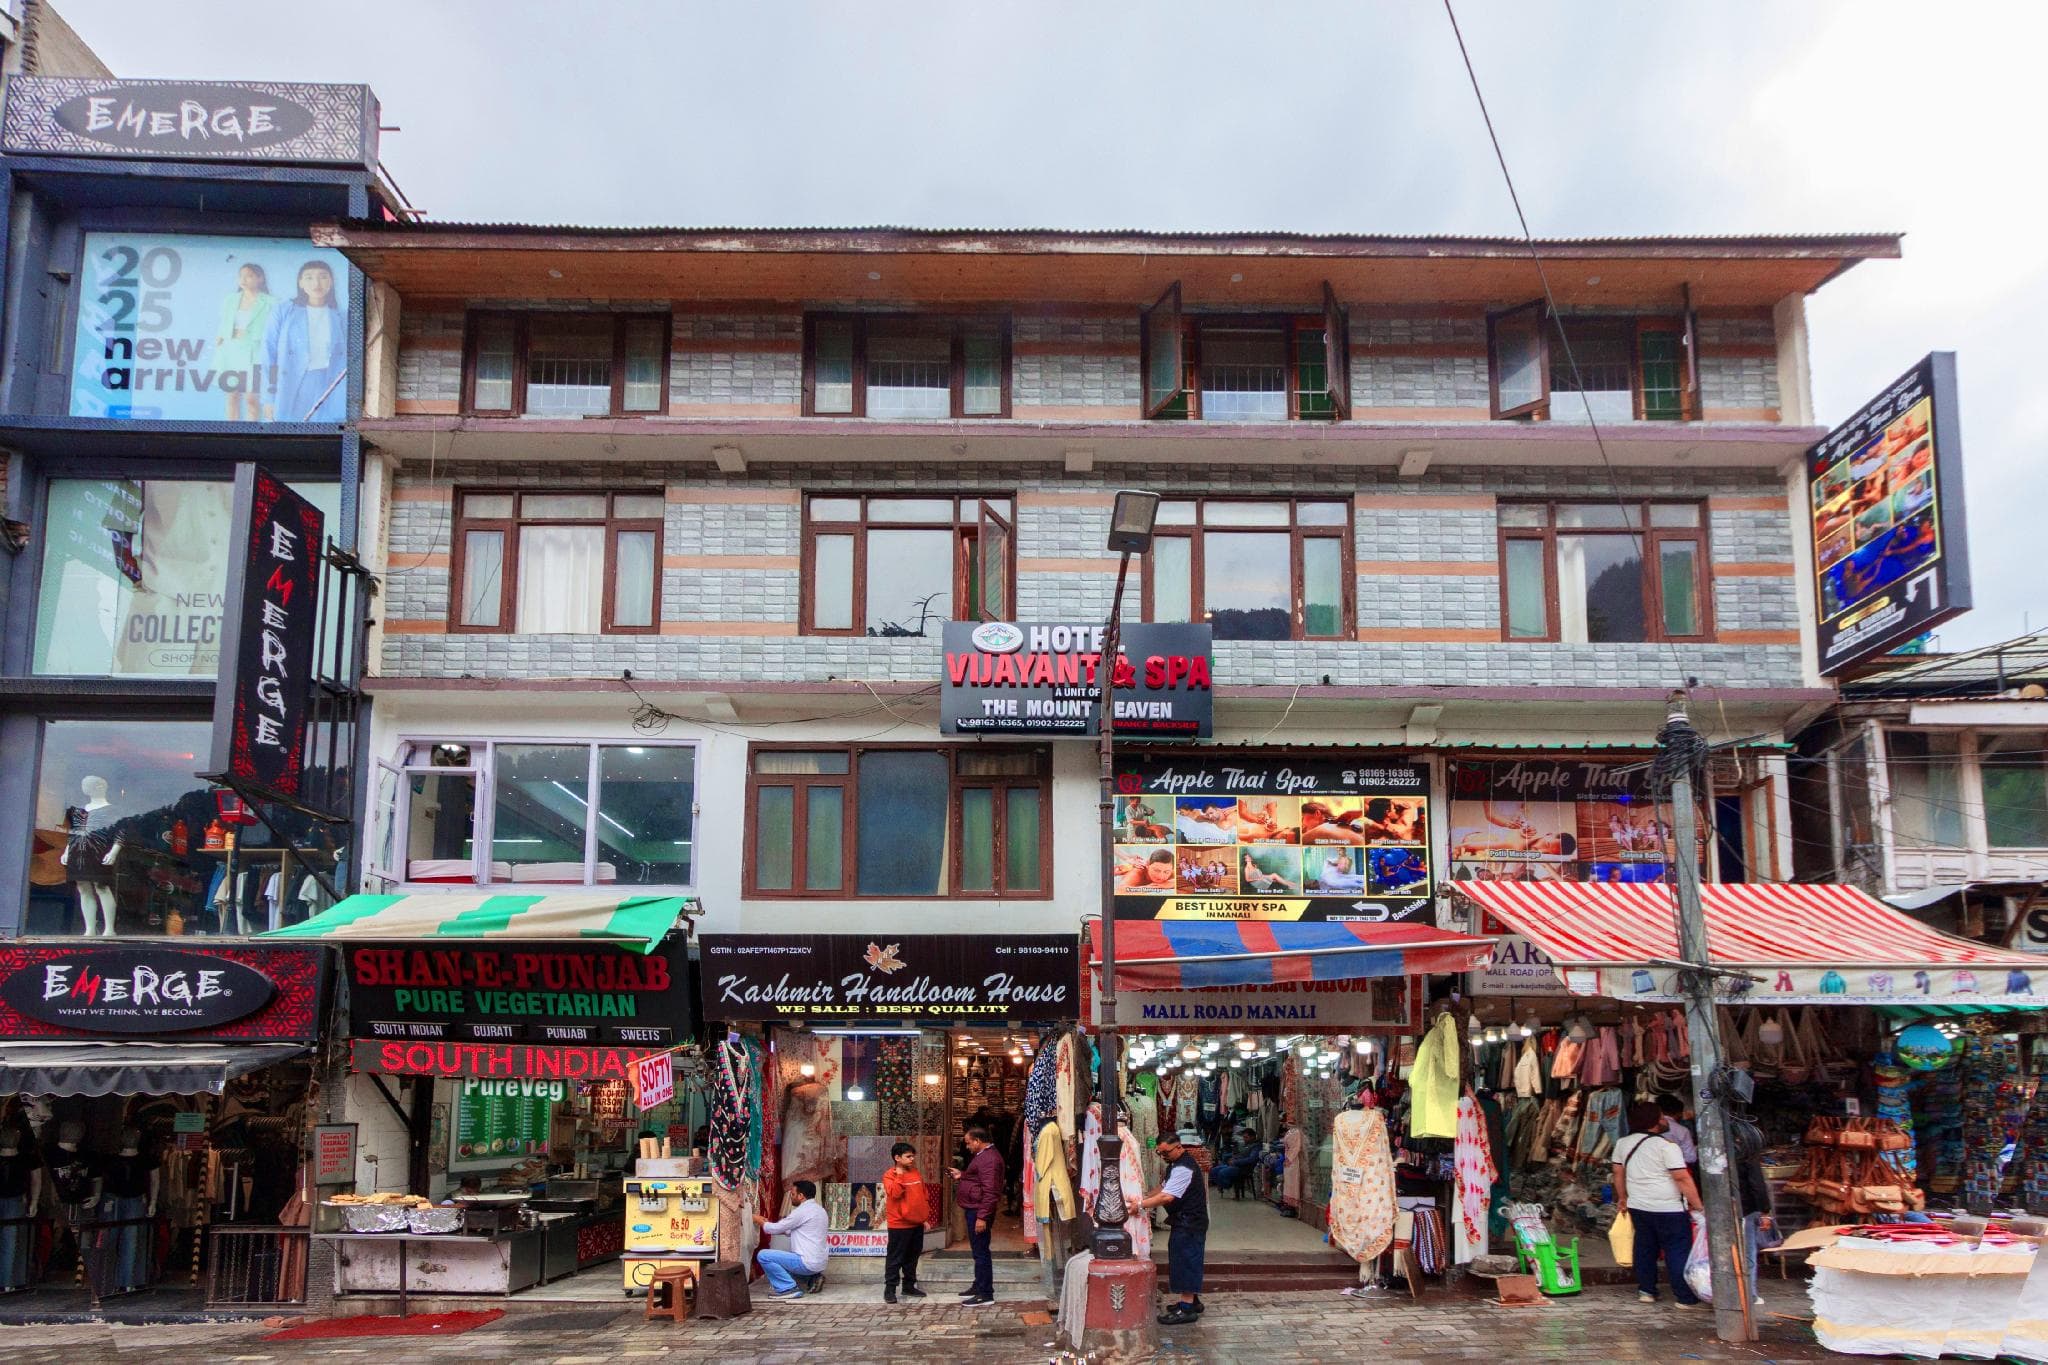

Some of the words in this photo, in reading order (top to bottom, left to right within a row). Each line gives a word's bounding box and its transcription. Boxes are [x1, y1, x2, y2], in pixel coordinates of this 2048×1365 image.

[86, 98, 277, 142] EMERGE
[102, 246, 182, 288] 20
[98, 291, 174, 332] 25
[105, 336, 205, 361] new
[101, 358, 279, 393] arrival!
[176, 593, 225, 608] NEW
[255, 520, 296, 745] EMERGE
[161, 653, 195, 663] SHOP
[947, 653, 1102, 687] VIJAYANT
[1112, 655, 1136, 688] &
[1145, 655, 1212, 689] SPA
[1055, 688, 1062, 696] A
[1064, 688, 1087, 696] UNIT
[1088, 688, 1101, 696] OF
[982, 700, 1019, 717] THE
[1027, 700, 1092, 718] MOUNT
[1100, 701, 1173, 718] EAVEN
[1150, 768, 1214, 794] Apple
[1222, 768, 1267, 790] Thai
[1276, 768, 1319, 794] Spa
[1495, 763, 1570, 793] Apple
[1175, 902, 1206, 911] BEST
[1209, 902, 1259, 911] LUXURY
[1262, 902, 1288, 912] SPA
[1392, 899, 1428, 920] Backside
[995, 946, 1011, 954] Cell
[354, 949, 671, 991] SHAN-E-PUNJAB
[1510, 968, 1533, 976] ROAD
[43, 965, 225, 1006] EMERGE
[718, 973, 833, 1004] Kashmir
[840, 973, 976, 1004] Handloom
[984, 973, 1066, 1003] House
[90, 1008, 106, 1016] WE
[395, 989, 464, 1013] PURE
[475, 991, 636, 1017] VEGETARIAN
[776, 1005, 806, 1013] WE
[811, 1005, 859, 1013] SALE
[876, 1005, 923, 1013] BEST
[928, 1005, 1010, 1014] QUALITY
[1142, 1005, 1189, 1019] MALL
[1194, 1005, 1243, 1019] ROAD
[1248, 1005, 1316, 1019] MANALI
[374, 1023, 405, 1036] SOUTH
[409, 1024, 443, 1036] INDIAN
[473, 1025, 513, 1038] GUJRATI
[547, 1027, 587, 1040] PUNJABI
[621, 1028, 660, 1041] SWEETS
[381, 1043, 513, 1074] SOUTH
[641, 1056, 671, 1093] SOFTY
[464, 1077, 563, 1101] PureVeg
[671, 1218, 680, 1230] Rs
[681, 1219, 690, 1230] 50
